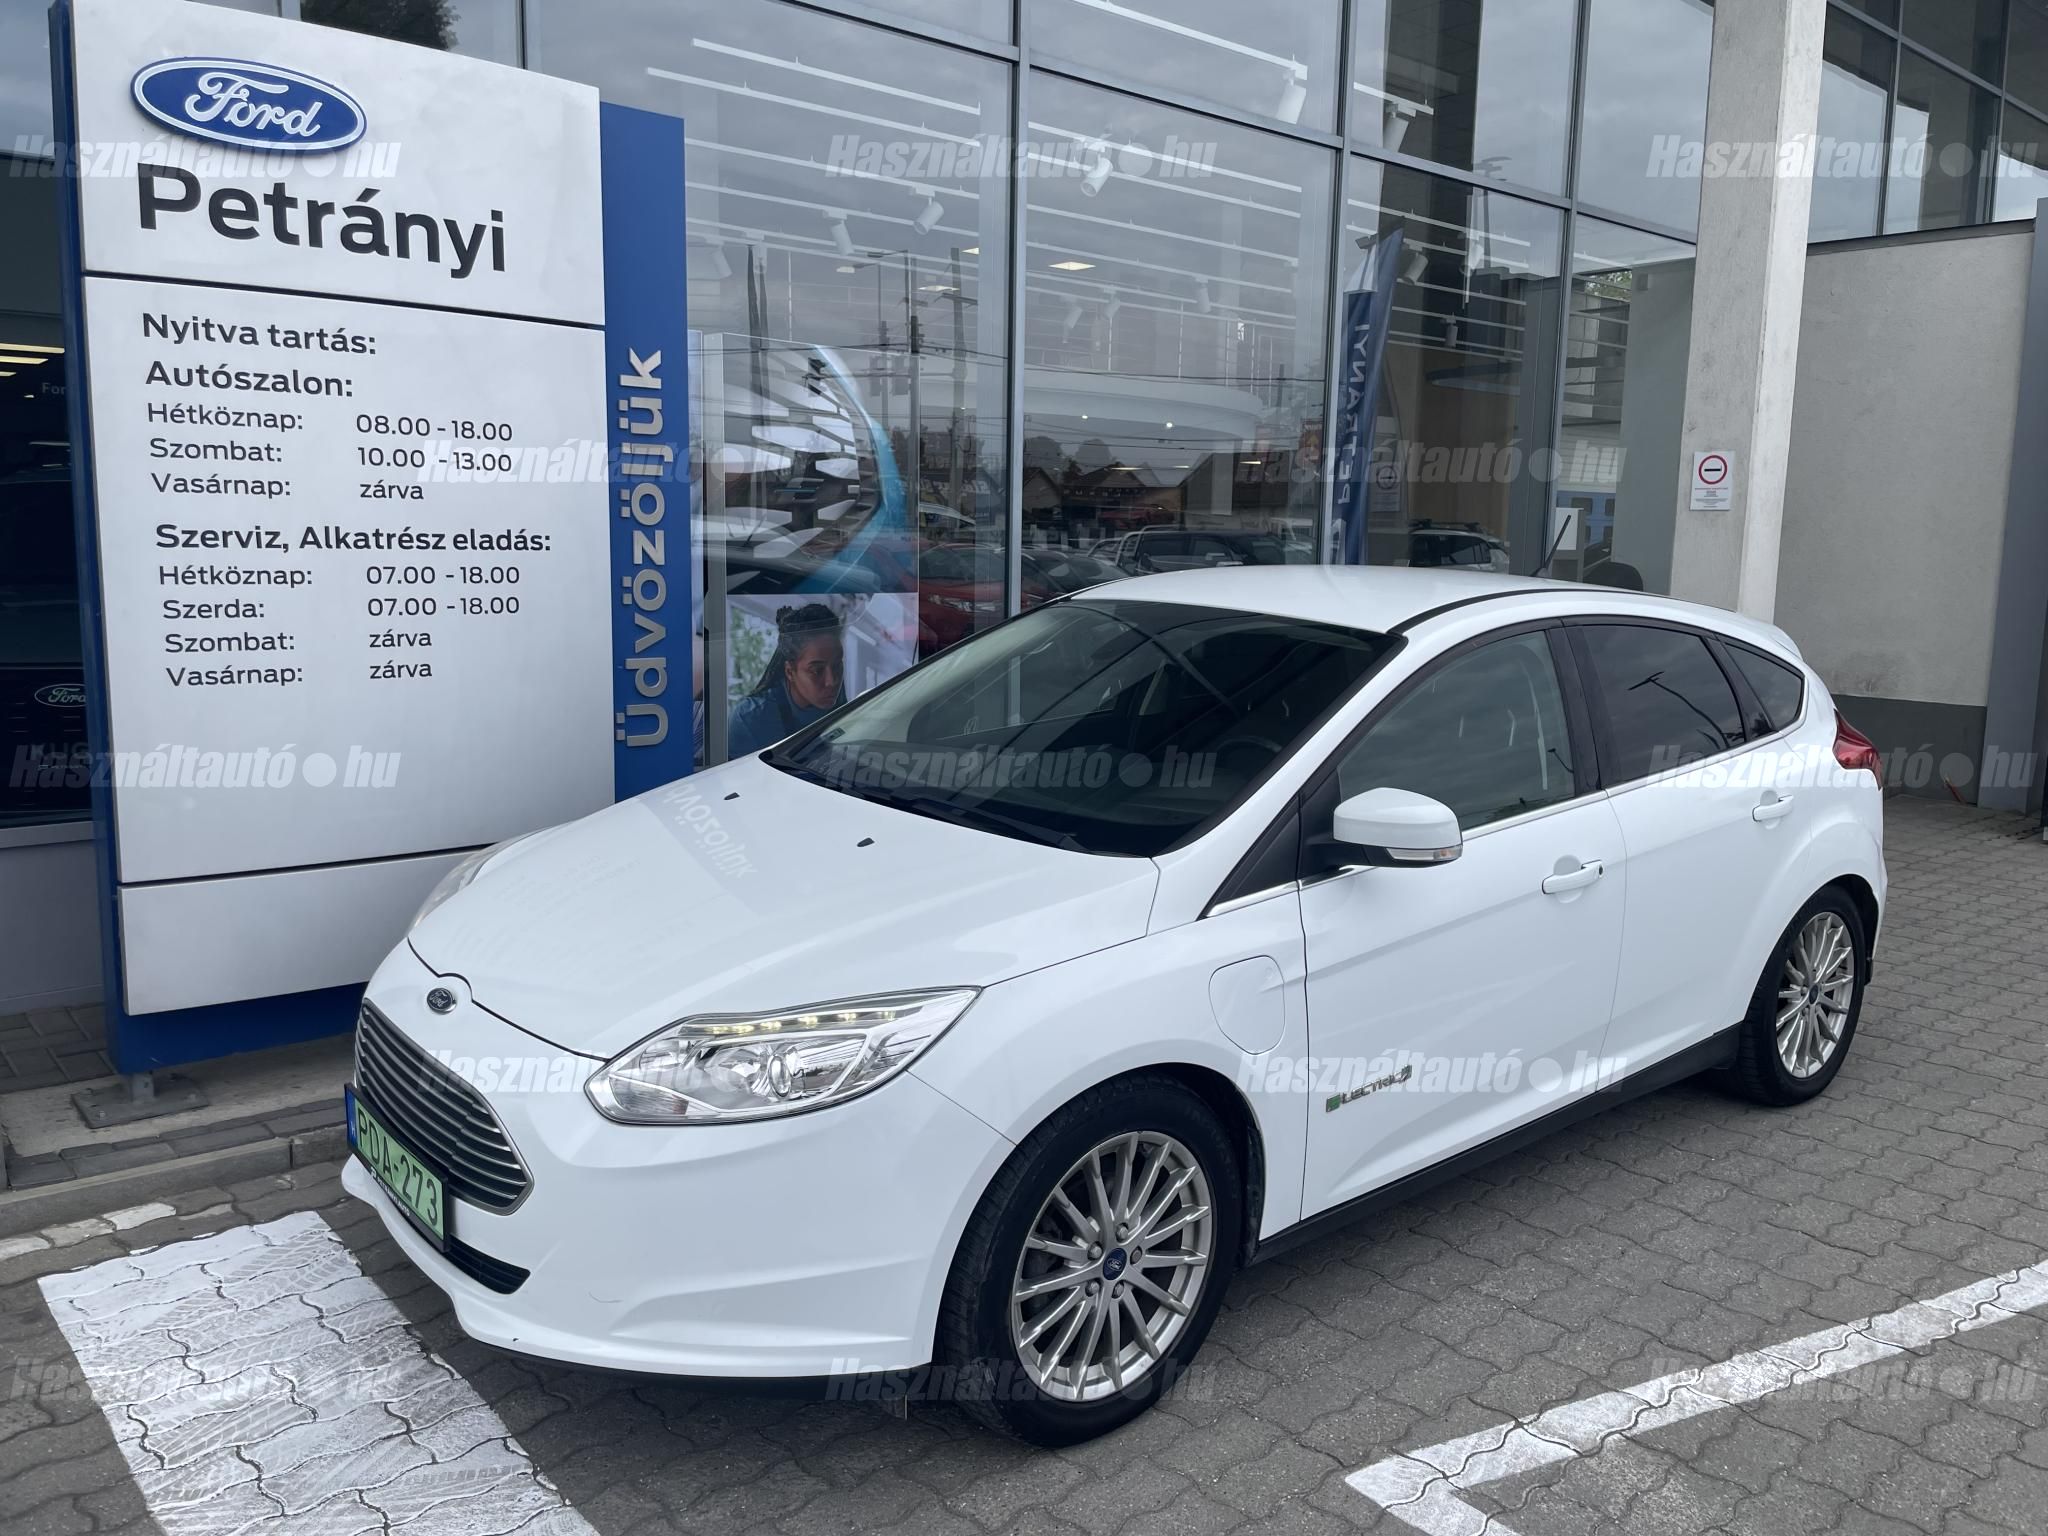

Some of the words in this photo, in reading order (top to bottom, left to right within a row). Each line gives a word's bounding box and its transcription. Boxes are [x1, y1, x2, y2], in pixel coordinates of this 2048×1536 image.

[184, 71, 323, 137] Ford
[137, 162, 506, 280] Petrányi
[142, 312, 260, 347] Nyitva
[267, 321, 377, 356] tartás:
[145, 359, 355, 398] Autószalon:
[147, 402, 303, 434] Hétköznap:
[356, 414, 431, 438] 08.00
[149, 437, 282, 463] Szombat:
[357, 446, 425, 469] 10.00
[151, 472, 291, 499] Vasárnap:
[359, 479, 424, 501] zárva
[155, 524, 290, 554] Szerviz,
[299, 525, 447, 551] Alkatrész
[452, 527, 552, 552] eladás:
[615, 347, 673, 747] Üdvözöljük
[159, 564, 313, 590] Hétköznap:
[366, 566, 436, 585] 07.00
[163, 598, 265, 620] Szerda:
[367, 597, 437, 617] 07.00
[165, 631, 295, 654] Szombat:
[369, 628, 432, 649] zárva
[166, 664, 303, 688] Vasárnap:
[369, 659, 433, 680] zárva
[357, 1107, 439, 1227] PDA-273
